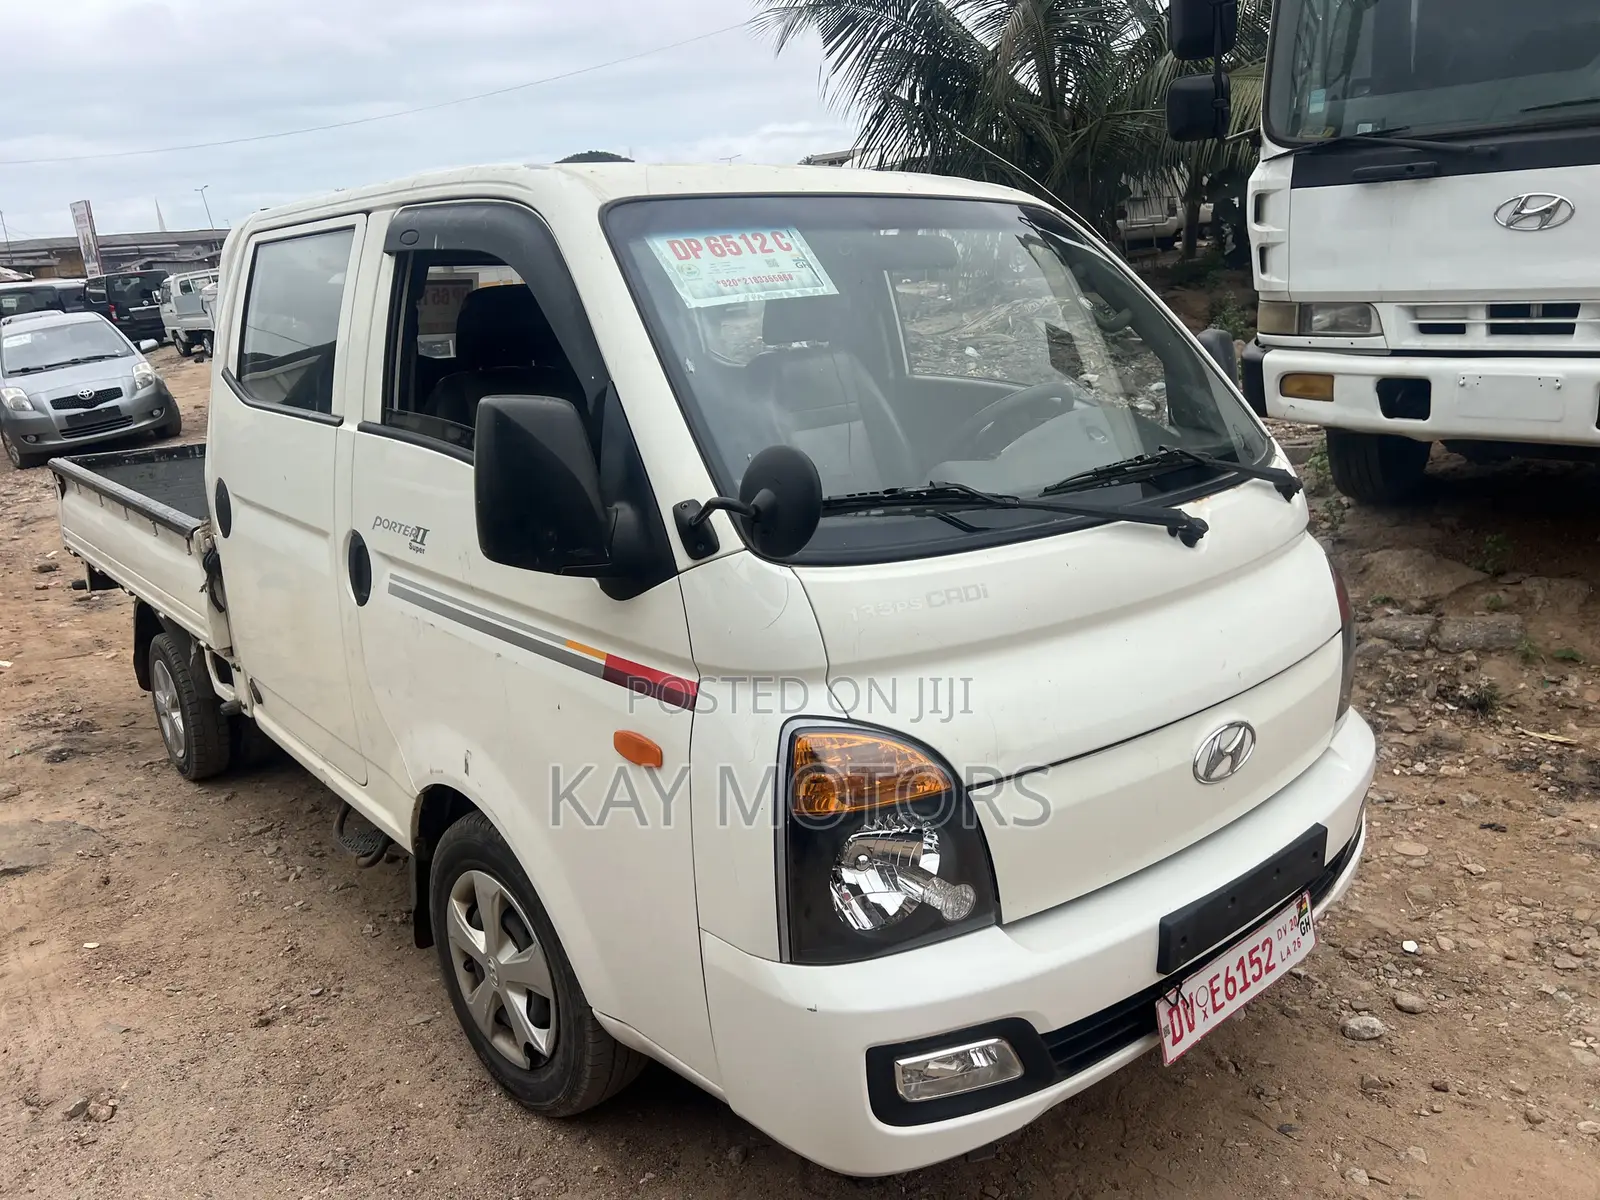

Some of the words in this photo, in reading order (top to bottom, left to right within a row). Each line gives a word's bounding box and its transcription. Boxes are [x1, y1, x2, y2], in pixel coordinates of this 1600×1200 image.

[666, 237, 704, 261] DP
[704, 232, 775, 258] 6512
[770, 231, 793, 252] C
[371, 515, 418, 538] PORTER
[408, 542, 425, 554] Super
[1276, 923, 1287, 941] DV
[1289, 915, 1298, 932] 20
[1300, 915, 1311, 937] GH
[1280, 945, 1292, 962] LA
[1292, 937, 1301, 953] 26
[1167, 991, 1195, 1047] DV
[1208, 936, 1276, 1014] E6152
